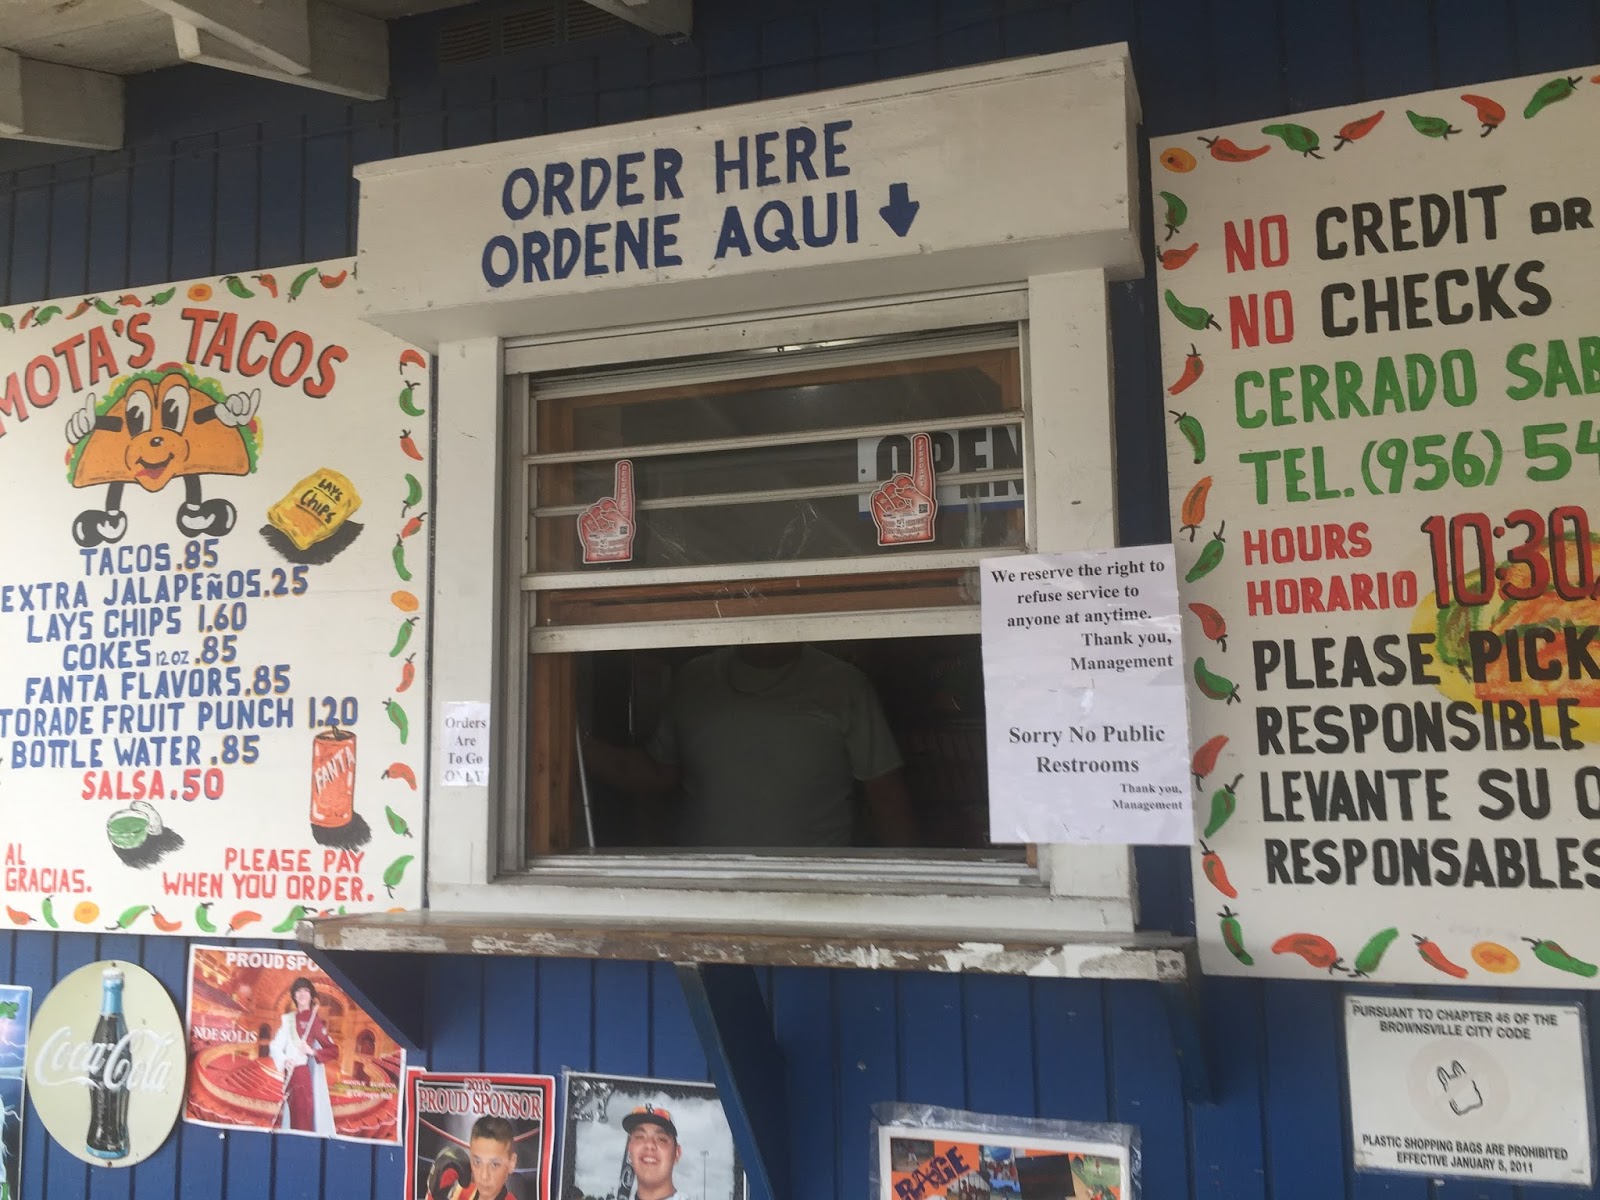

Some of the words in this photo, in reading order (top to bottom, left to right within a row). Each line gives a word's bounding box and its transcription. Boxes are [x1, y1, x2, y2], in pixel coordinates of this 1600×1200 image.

[502, 148, 684, 221] ORDER
[714, 120, 853, 194] HERE
[481, 213, 682, 289] ORDENE
[714, 189, 858, 260] AQUI
[1224, 214, 1289, 274] NO
[1315, 184, 1507, 261] CREDIT
[1529, 197, 1594, 235] OR
[1228, 289, 1294, 349] NO
[1320, 260, 1552, 338] CHECKS
[0, 312, 156, 438] MOTA'S
[181, 307, 349, 399] TACOS
[1234, 349, 1478, 429] CERRADO
[1238, 446, 1355, 505] TEL.
[1361, 429, 1503, 496] (956)
[1523, 420, 1600, 482] 54
[80, 543, 172, 576] TACOS
[1243, 522, 1372, 566] HOURS
[991, 568, 1016, 584] We
[1020, 566, 1074, 582] reserve
[1077, 562, 1103, 578] the
[1107, 558, 1145, 580] right
[1149, 559, 1165, 574] to
[1, 581, 88, 613] EXTRA
[1017, 588, 1063, 604] refuse
[1066, 585, 1120, 601] service
[1124, 586, 1140, 600] to
[1246, 570, 1418, 617] HORARIO
[27, 611, 94, 643] LAYS
[104, 605, 182, 639] CHIPS
[198, 602, 248, 634] 1.60
[1007, 613, 1061, 631] anyone
[1065, 612, 1081, 625] at
[1084, 607, 1153, 625] anytime.
[62, 639, 152, 672] COKES
[194, 635, 238, 665] .85
[1081, 632, 1134, 647] Thank
[1137, 633, 1172, 648] you,
[1070, 655, 1174, 674] Management
[1252, 632, 1442, 692] PLEASE
[1469, 625, 1600, 684] PICK
[25, 674, 108, 705] FANTA
[121, 667, 243, 701] FLAVORS
[102, 703, 186, 735] FRUIT
[198, 697, 295, 732] PUNCH
[307, 696, 360, 730] 1.20
[445, 717, 487, 729] Orders
[1256, 697, 1585, 755] RESPONSIBLE
[11, 739, 104, 769] BOTTLE
[113, 734, 201, 767] WATER
[210, 734, 261, 766] .85
[455, 735, 477, 747] Are
[1009, 726, 1063, 747] Sorry
[1069, 726, 1096, 743] No
[1103, 725, 1165, 743] Public
[315, 745, 356, 796] FANTA
[448, 752, 463, 764] To
[465, 752, 483, 764] Go
[1036, 756, 1140, 774] Restrooms
[81, 770, 165, 801] SALSA
[1119, 783, 1155, 794] Thank
[1158, 784, 1183, 797] you,
[1261, 768, 1452, 823] LEVANTE
[1477, 767, 1552, 821] SU
[1112, 799, 1183, 811] Management
[5, 843, 26, 866] AL
[225, 849, 312, 873] PLEASE
[323, 850, 365, 873] PAY
[1265, 837, 1600, 890] RESPONSABLES
[5, 867, 93, 894] GRACIAS.
[162, 872, 224, 898] WHEN
[233, 873, 277, 900] YOU
[286, 874, 375, 903] ORDER.
[226, 952, 285, 970] PROUD
[1352, 1005, 1414, 1020] PURSUANT
[1418, 1008, 1434, 1021] TO
[1436, 1009, 1494, 1024] CHAPTER
[1514, 1012, 1531, 1025] OF
[1534, 1014, 1559, 1027] THE
[1379, 1020, 1463, 1037] BROWNSVILLE
[1466, 1025, 1493, 1038] CITY
[1496, 1026, 1532, 1040] CODE
[220, 1030, 258, 1043] SOLIS
[466, 1079, 491, 1092] 2016
[418, 1088, 471, 1113] PROUD
[472, 1090, 544, 1120] SPONSOR
[1362, 1133, 1402, 1148] PLASTIC
[1404, 1138, 1453, 1153] SHOPPING
[1456, 1141, 1483, 1154] BAGS
[1486, 1144, 1505, 1156] ARE
[1508, 1145, 1568, 1161] PROHIBITED
[1396, 1151, 1449, 1167] EFFECTIVE
[1450, 1156, 1495, 1170] JANUARY
[1510, 1161, 1533, 1173] 2011
